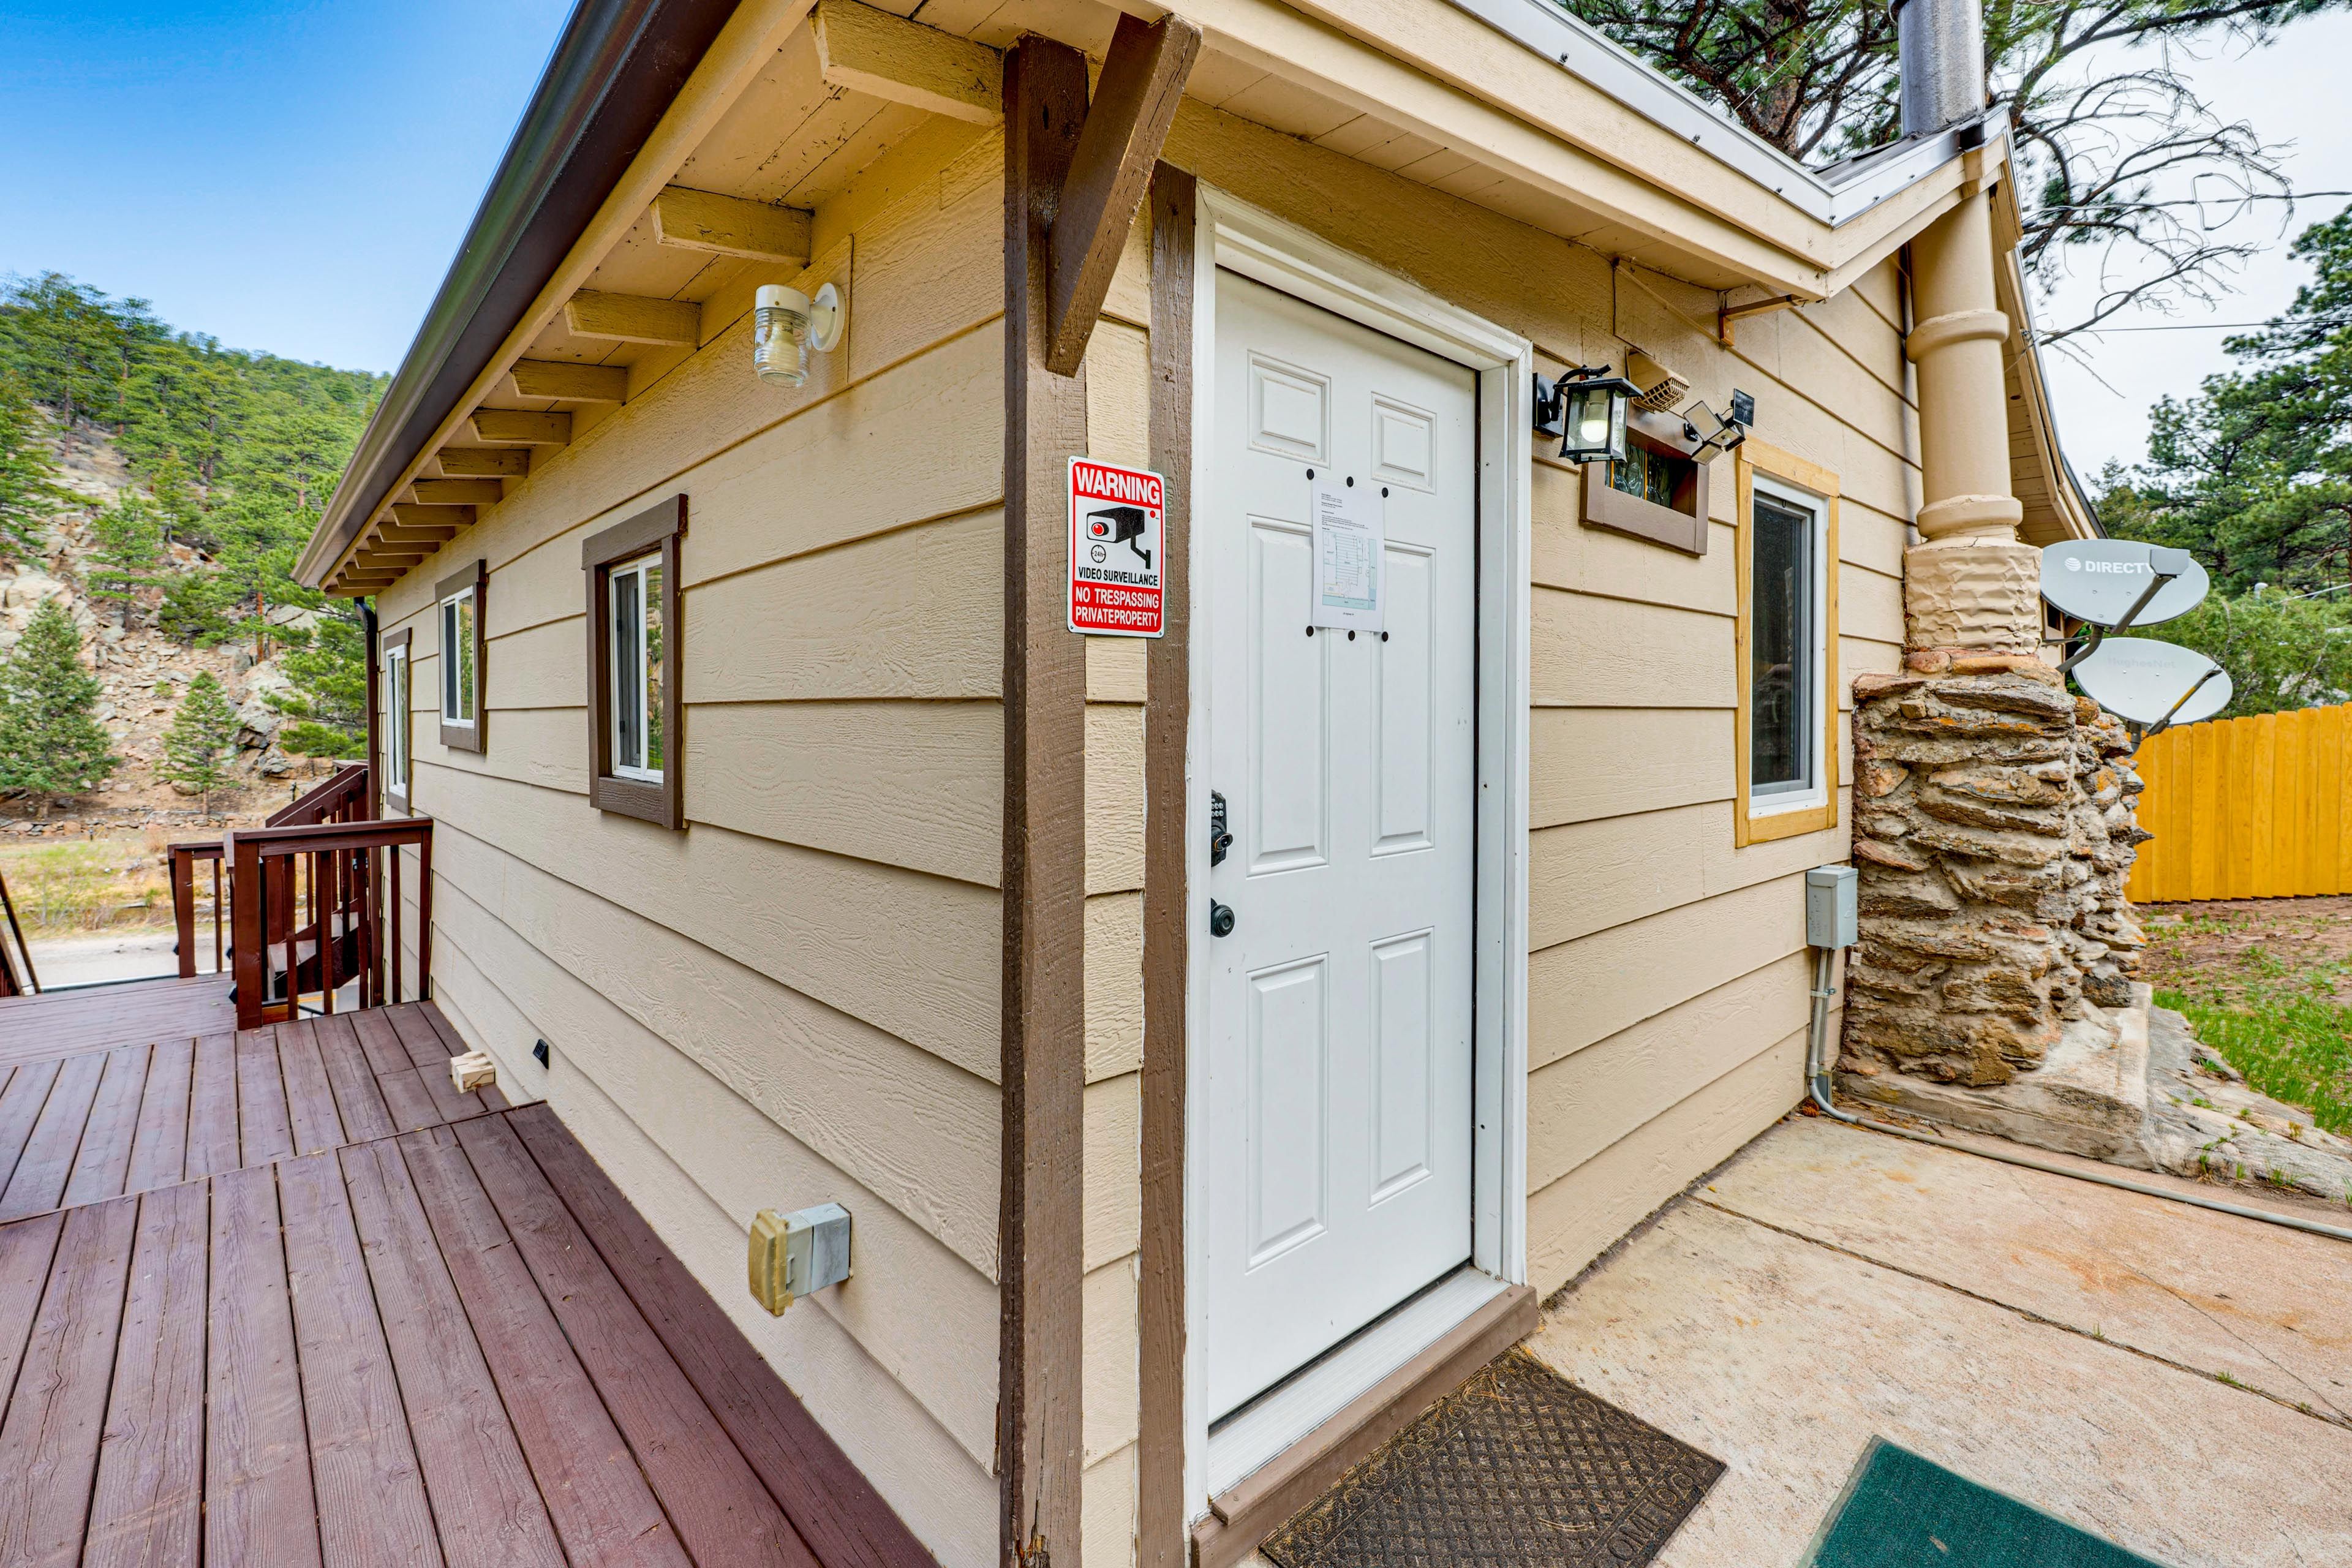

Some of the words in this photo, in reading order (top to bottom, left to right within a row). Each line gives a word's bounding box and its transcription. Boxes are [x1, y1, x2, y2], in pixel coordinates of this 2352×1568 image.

[1076, 466, 1160, 505] WARNING
[1079, 567, 1101, 580] VIDEO
[1104, 570, 1158, 586] SURVEILLANCE
[1076, 586, 1090, 603] NO
[1095, 588, 1159, 609] TRESPASSING
